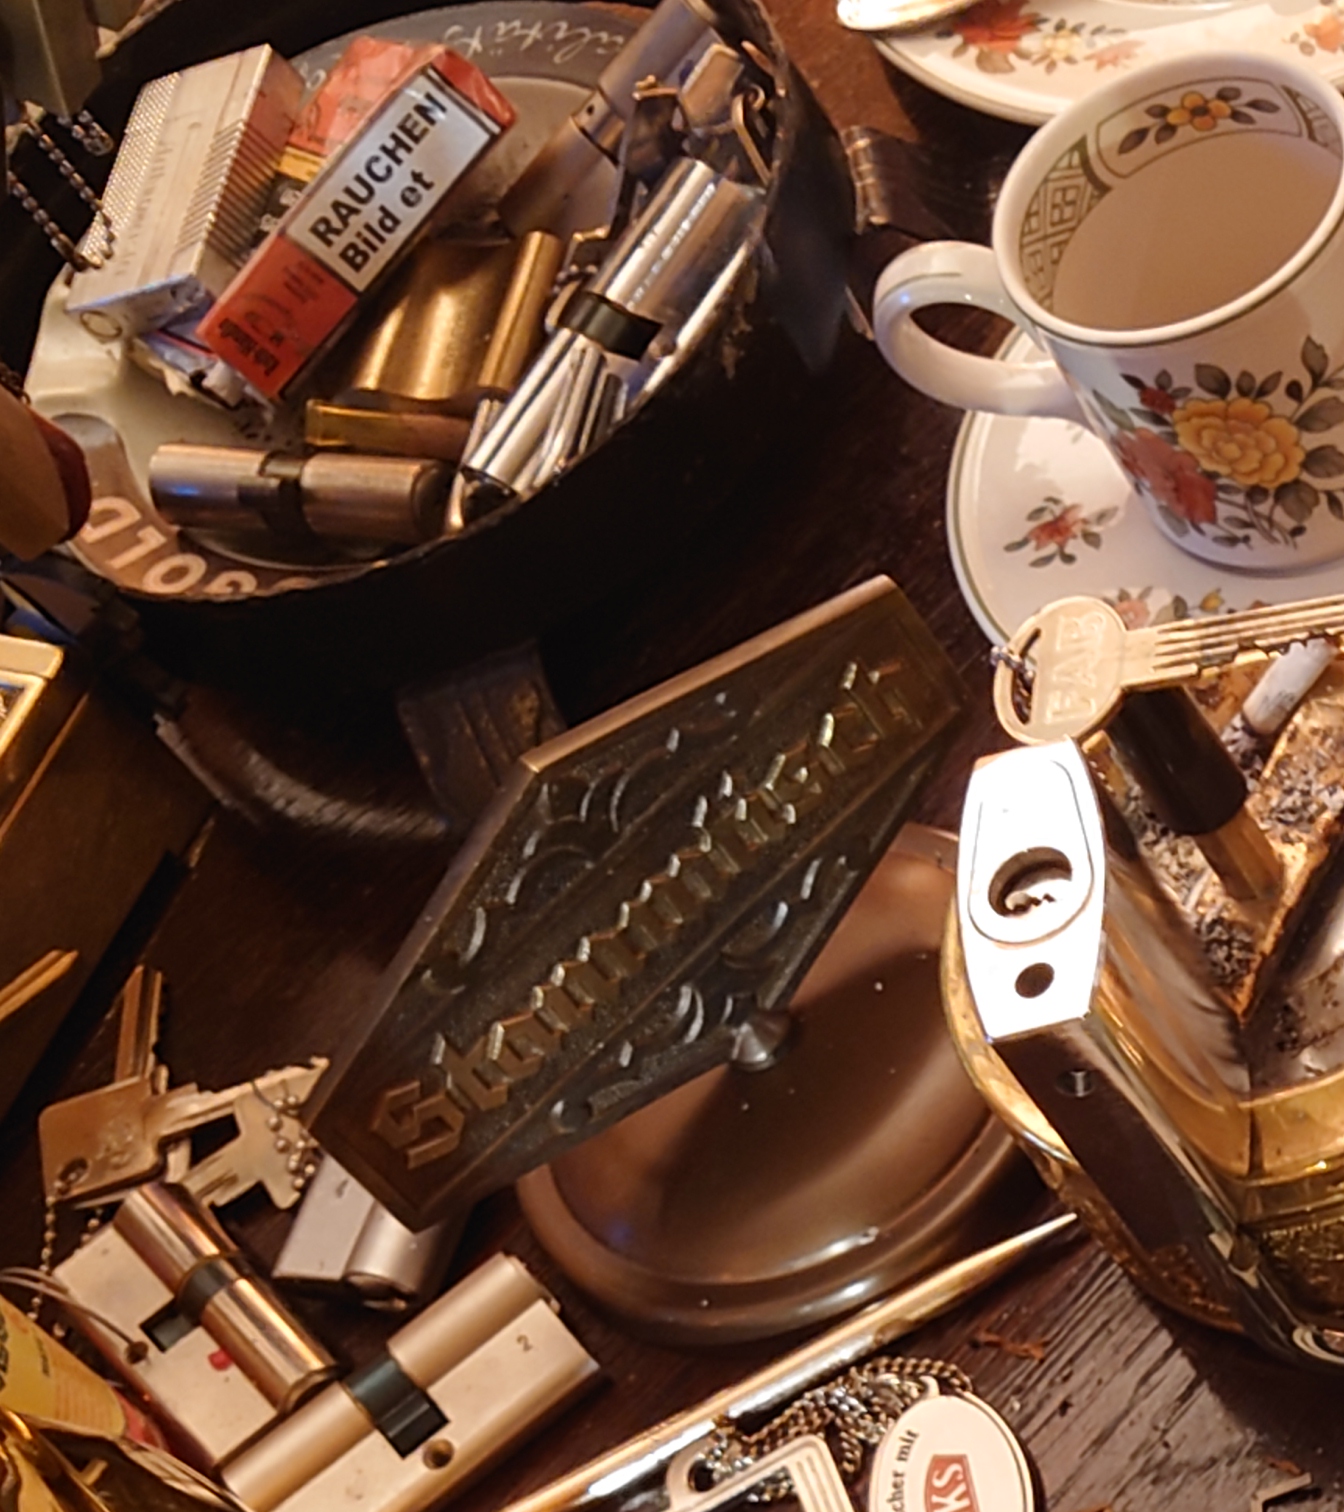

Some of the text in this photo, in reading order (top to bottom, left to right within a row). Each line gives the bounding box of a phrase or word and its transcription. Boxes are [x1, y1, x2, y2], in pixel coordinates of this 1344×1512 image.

[308, 91, 449, 251] RAUCHEN
[340, 169, 436, 276] Bild et
[896, 1428, 920, 1462] mit
